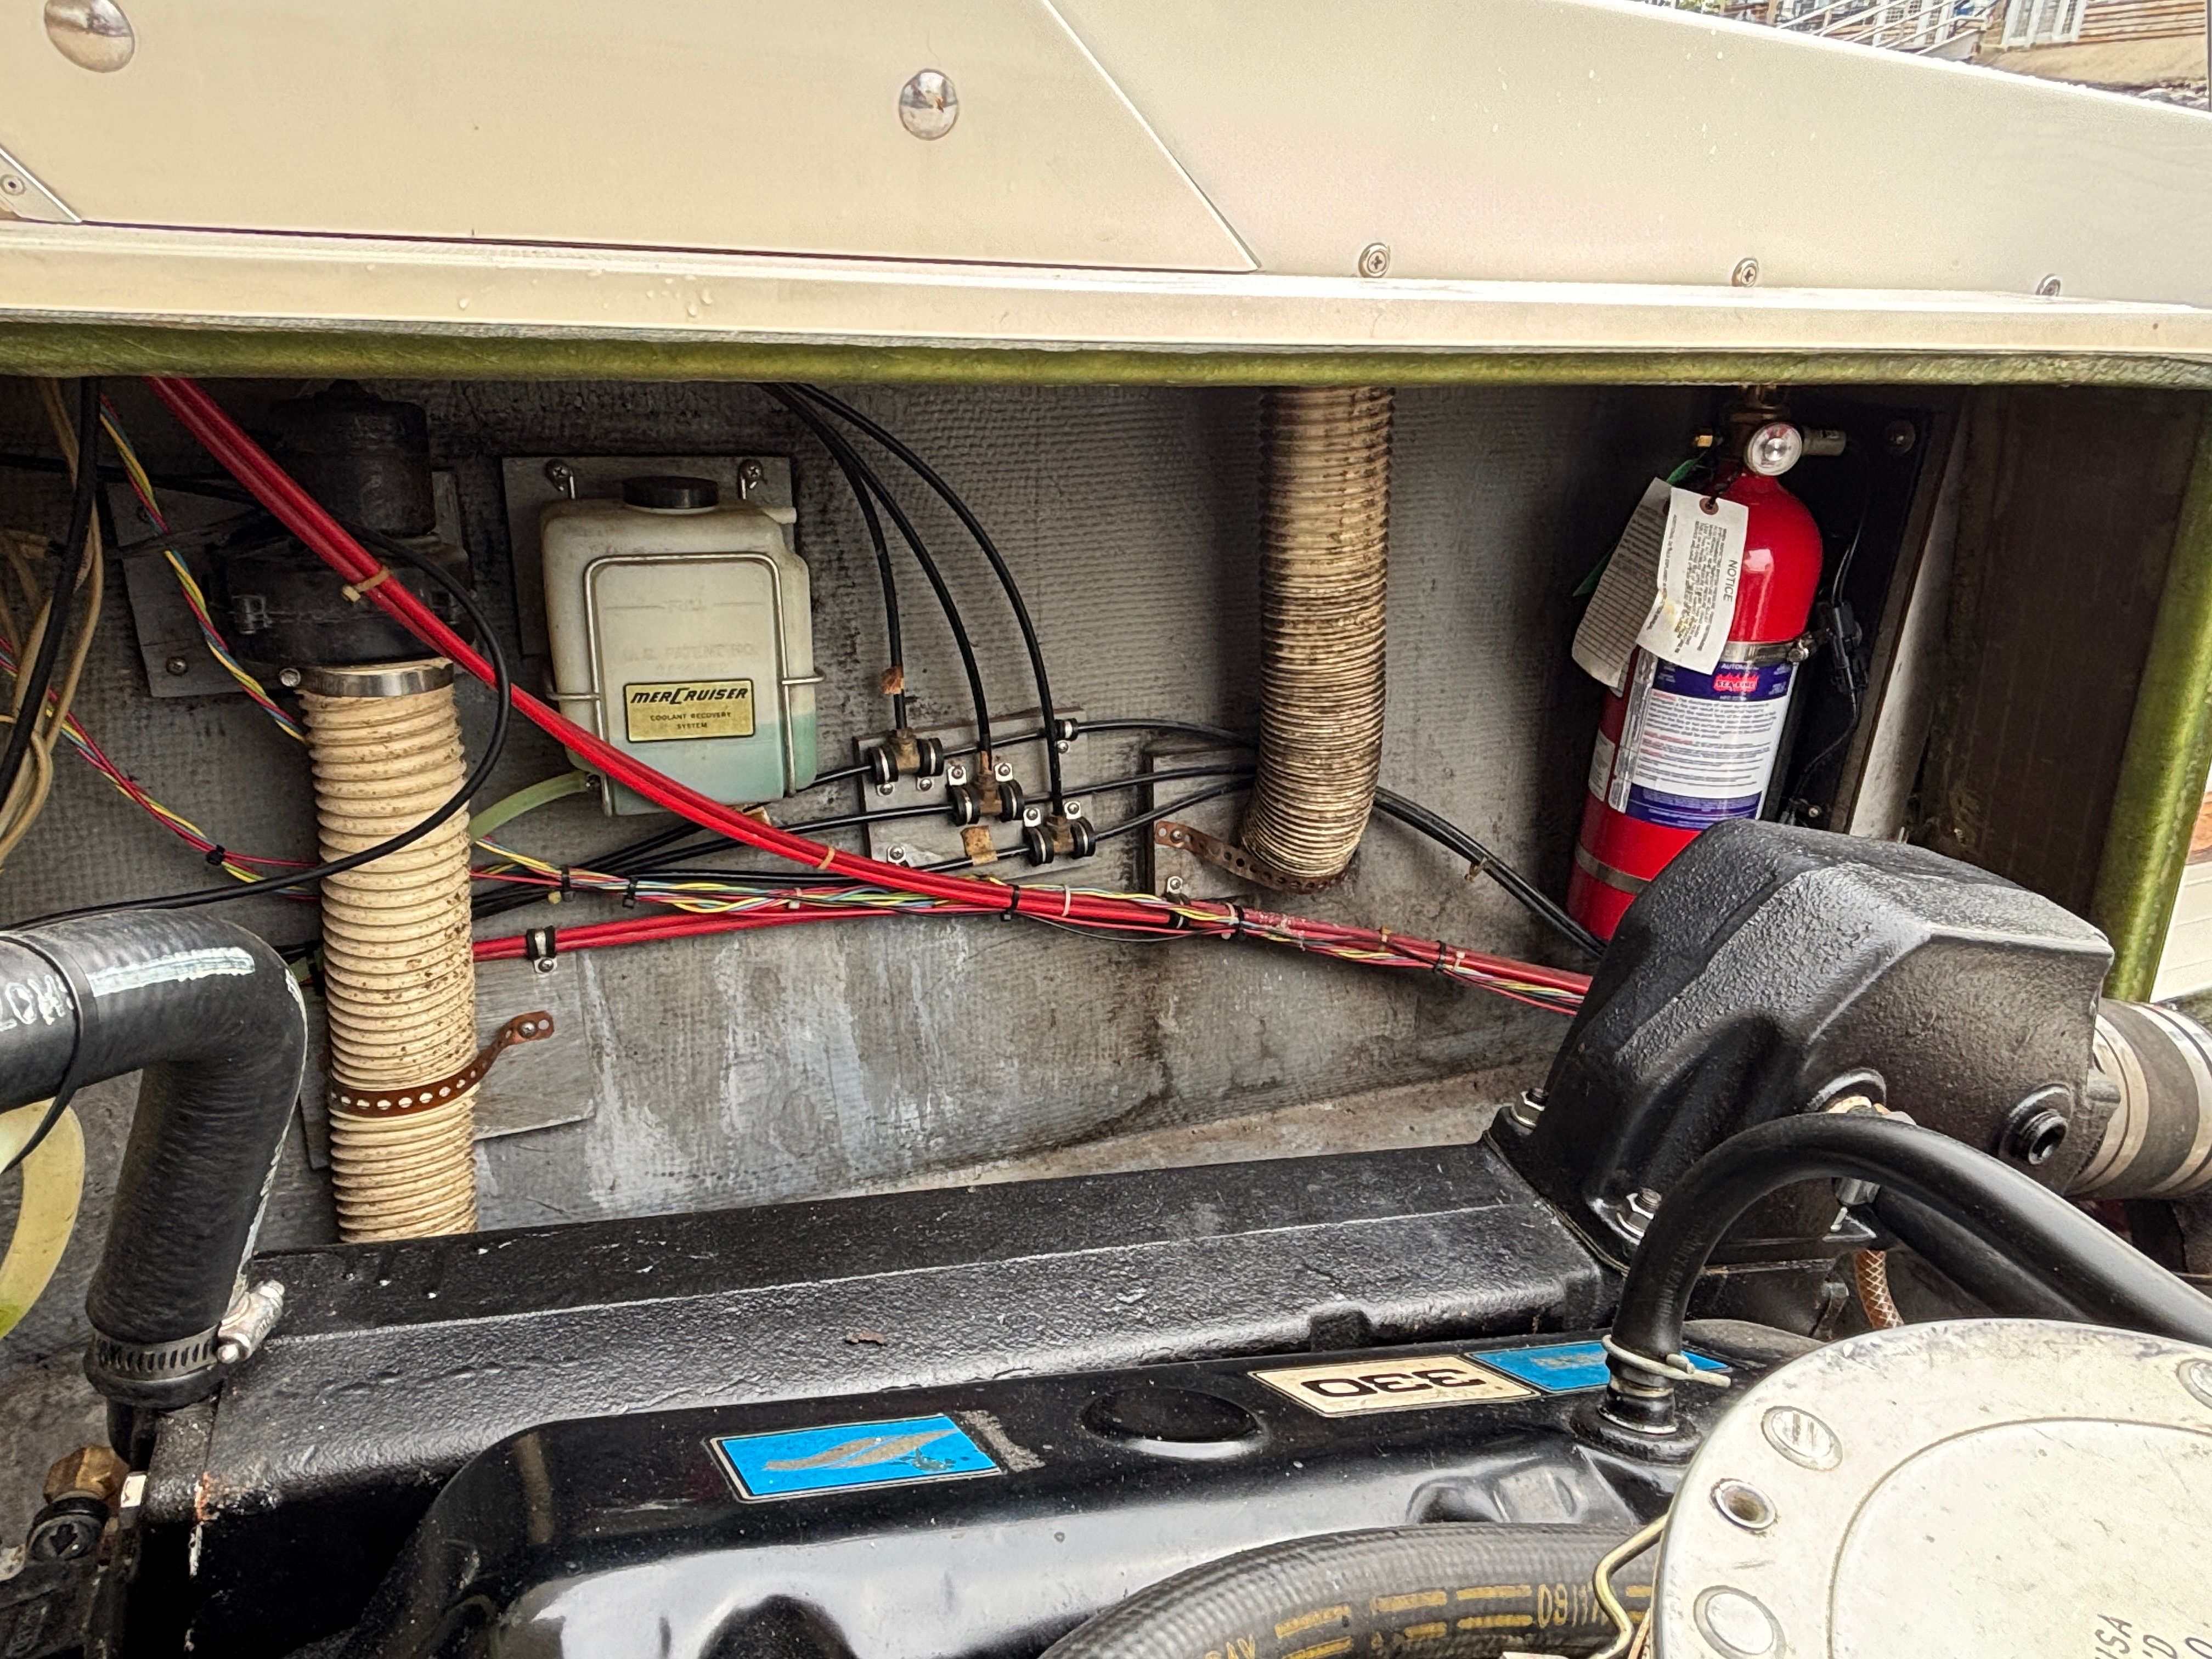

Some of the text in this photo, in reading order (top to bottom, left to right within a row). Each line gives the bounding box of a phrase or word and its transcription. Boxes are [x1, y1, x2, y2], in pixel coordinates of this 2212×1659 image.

[1723, 559, 1738, 602] NOTICE
[650, 711, 731, 721] COOLANT RECOVERY
[676, 721, 708, 730] SYSTEM
[1300, 1368, 1486, 1398] 330
